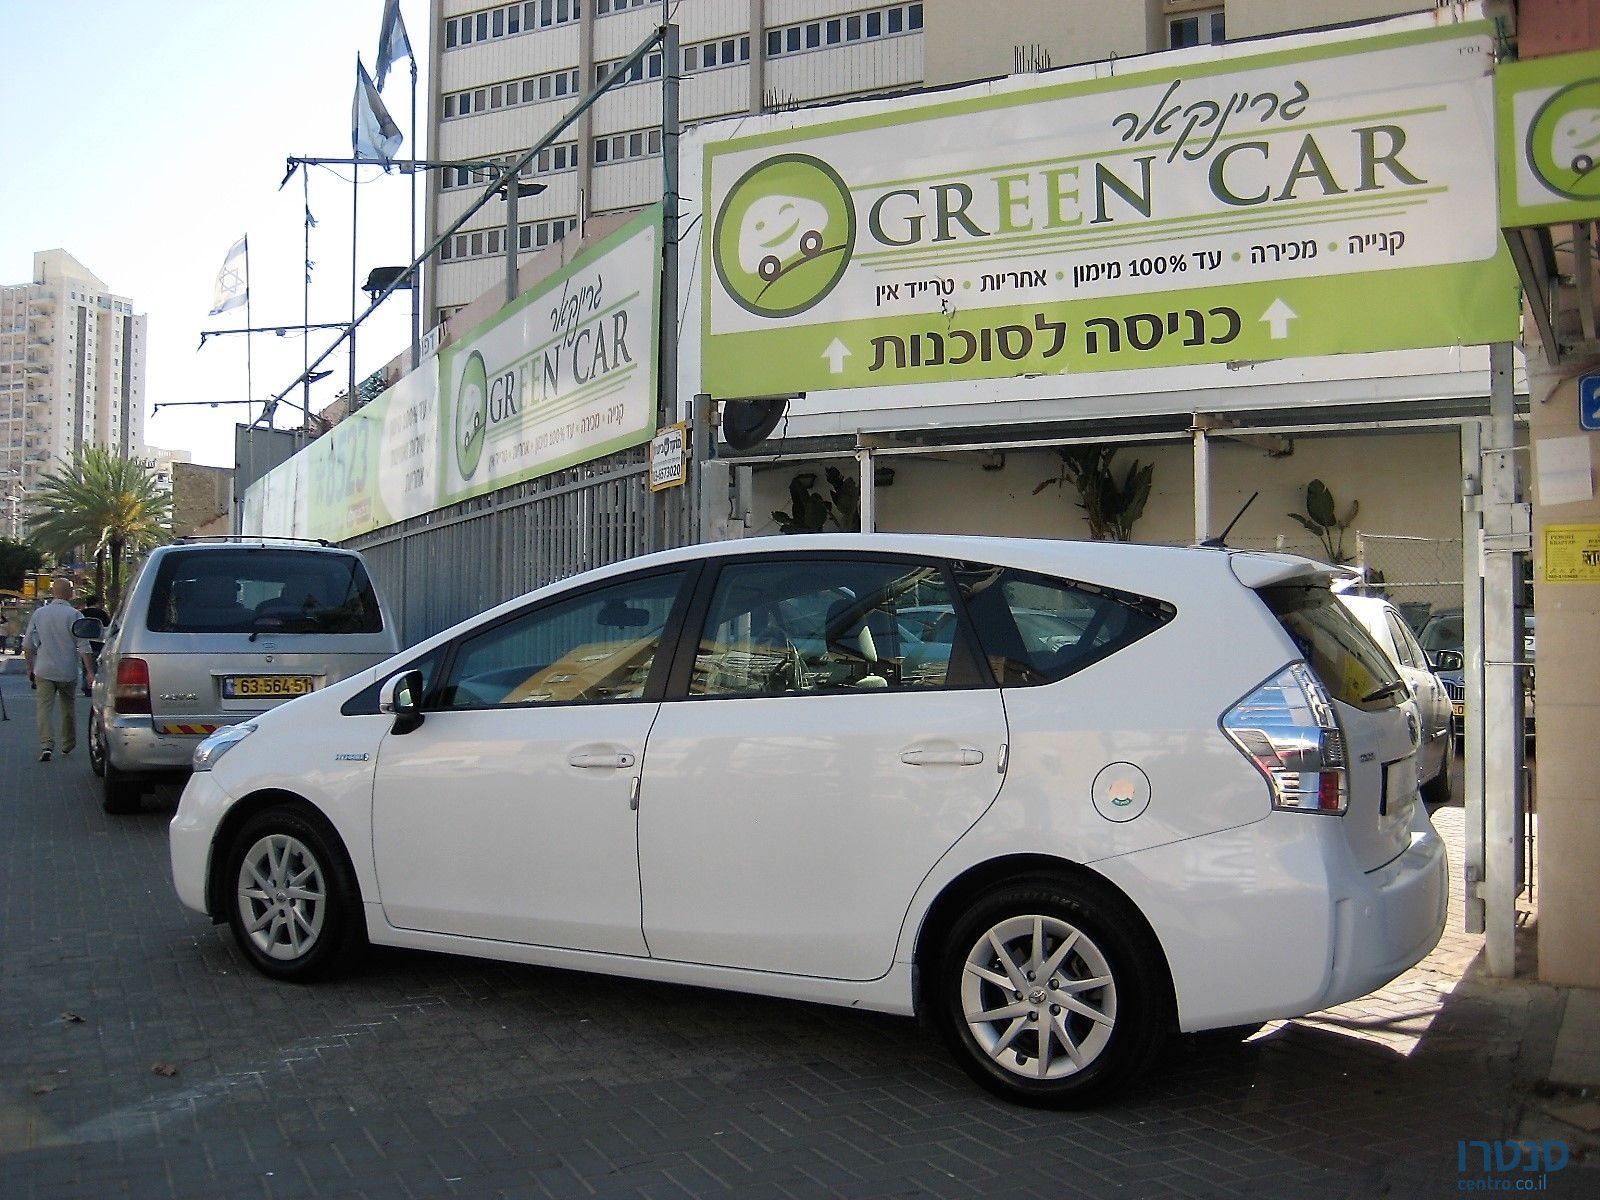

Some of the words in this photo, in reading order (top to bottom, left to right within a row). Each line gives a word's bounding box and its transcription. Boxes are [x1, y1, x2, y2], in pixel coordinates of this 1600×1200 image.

[1111, 78, 1310, 164] גרינקאר
[868, 154, 1157, 247] GREEN
[1208, 124, 1428, 206] CAR
[1250, 239, 1318, 265] מכירה
[1348, 229, 1406, 256] קנייה
[1128, 254, 1187, 278] 100%
[1192, 249, 1222, 271] עד
[979, 269, 1048, 292] אחריות
[1072, 260, 1122, 288] מימון
[875, 283, 899, 307] אין
[904, 278, 955, 299] טרייד
[867, 313, 1067, 372] לסוכנות
[1084, 306, 1242, 354] כניסה
[489, 344, 561, 424] GREEN
[572, 309, 633, 385] CAR
